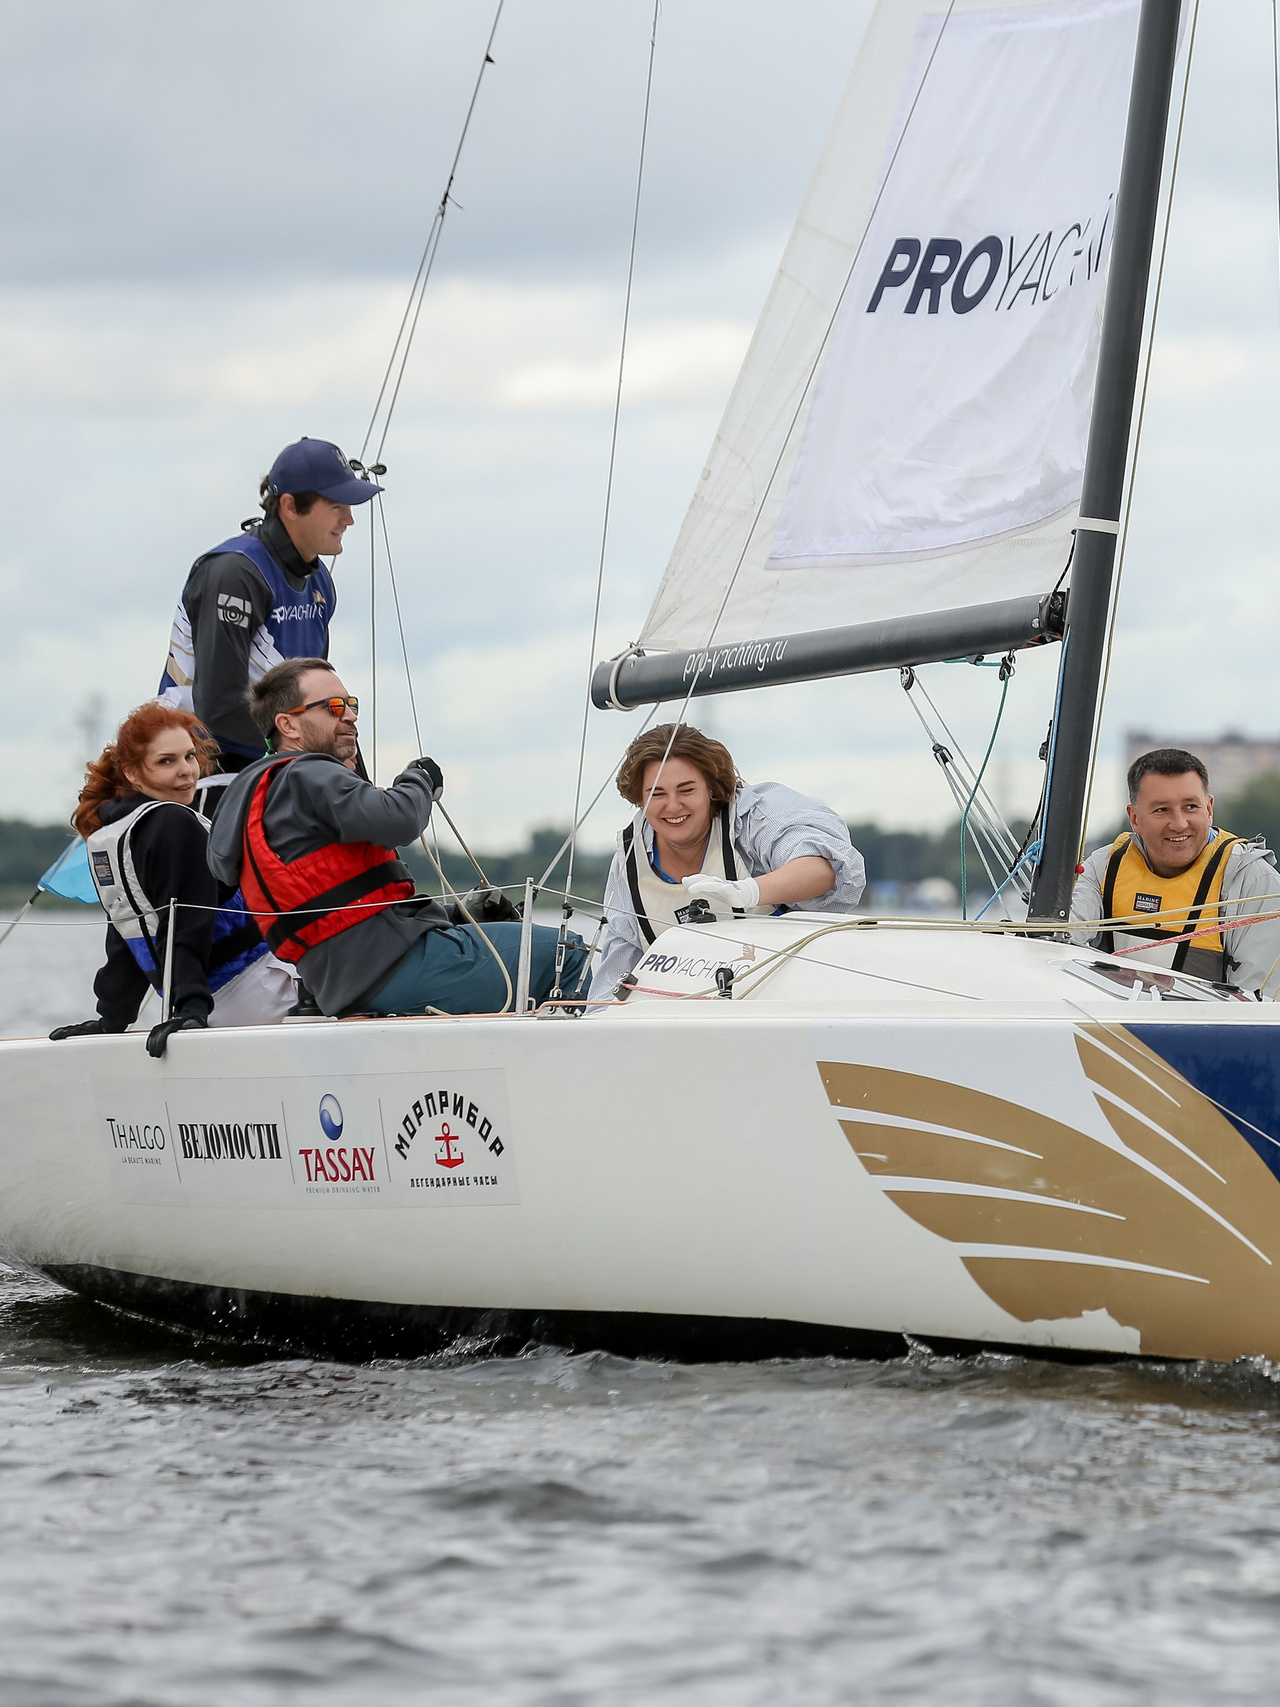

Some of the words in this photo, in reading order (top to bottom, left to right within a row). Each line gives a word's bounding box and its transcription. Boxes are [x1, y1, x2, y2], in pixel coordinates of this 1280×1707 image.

[177, 1123, 282, 1164] ВЕДОМОСТИ
[395, 1090, 505, 1161] МОРПРИБОР
[299, 1147, 376, 1182] TASSAY
[410, 1177, 471, 1188] ЛЕГЕНДАРНЫЕ
[473, 1175, 498, 1186] ЧАСЫ
